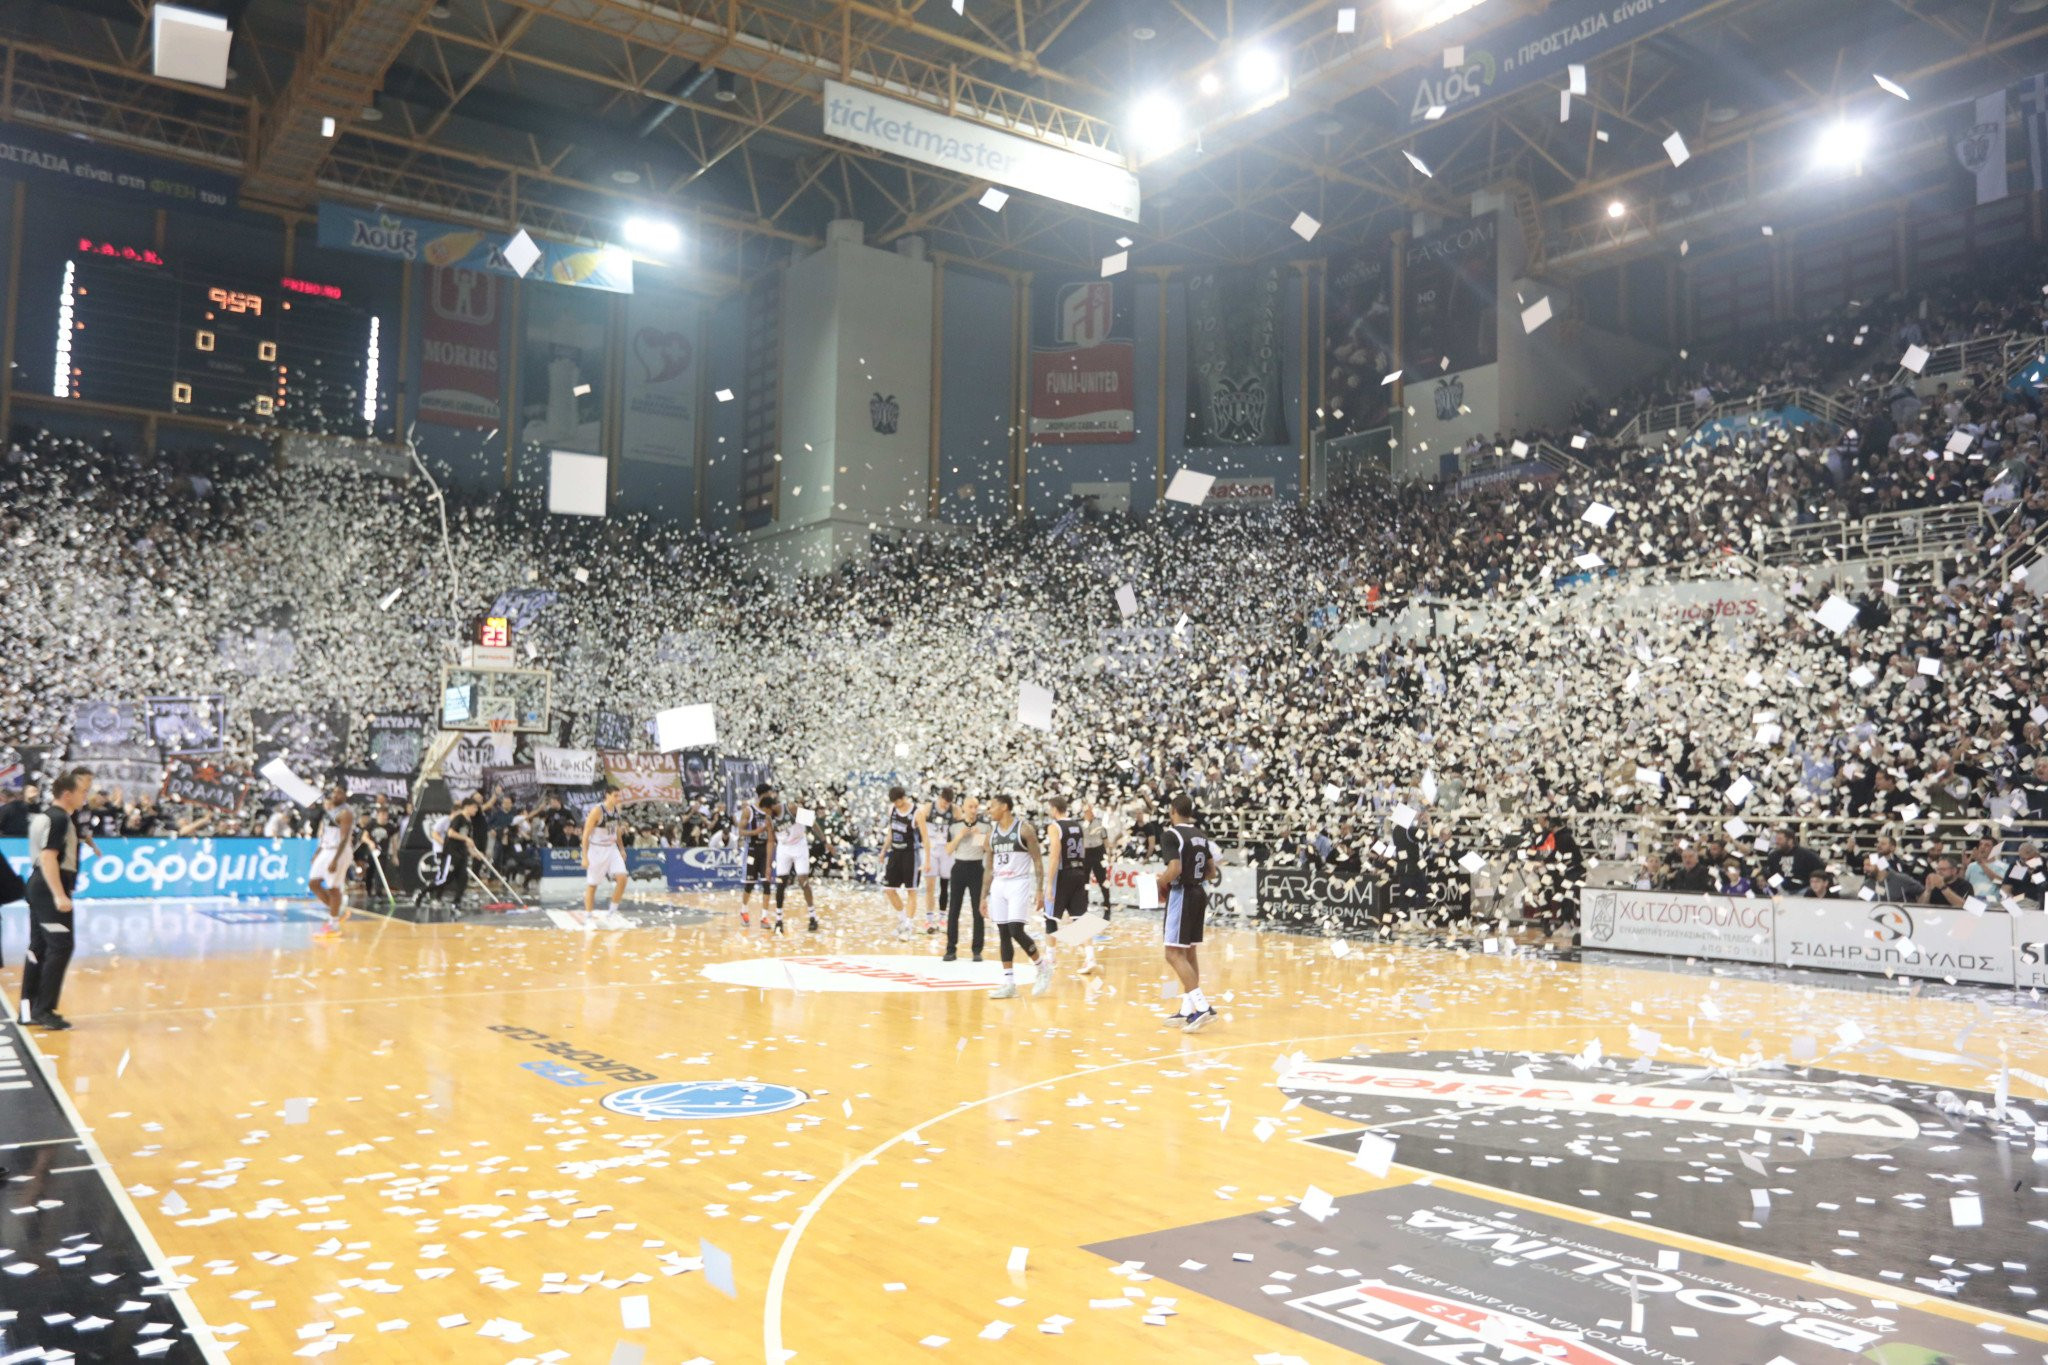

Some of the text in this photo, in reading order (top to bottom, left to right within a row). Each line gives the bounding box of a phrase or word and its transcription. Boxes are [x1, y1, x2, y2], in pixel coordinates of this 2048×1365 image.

[1518, 12, 1609, 67] ΠΡΟΣΤΑΣΙΑ
[829, 97, 1018, 174] ticketmaster
[423, 339, 498, 372] MORRIS
[1046, 371, 1119, 393] FUNAI-UNITED
[482, 625, 507, 647] 23
[997, 853, 1010, 866] 33
[1264, 875, 1373, 904] FARCOM
[1790, 941, 1995, 971] ΣΙΔΗΡΟΠΟΥΛΟΣ
[1405, 1208, 1883, 1354] BIOCLIMA
